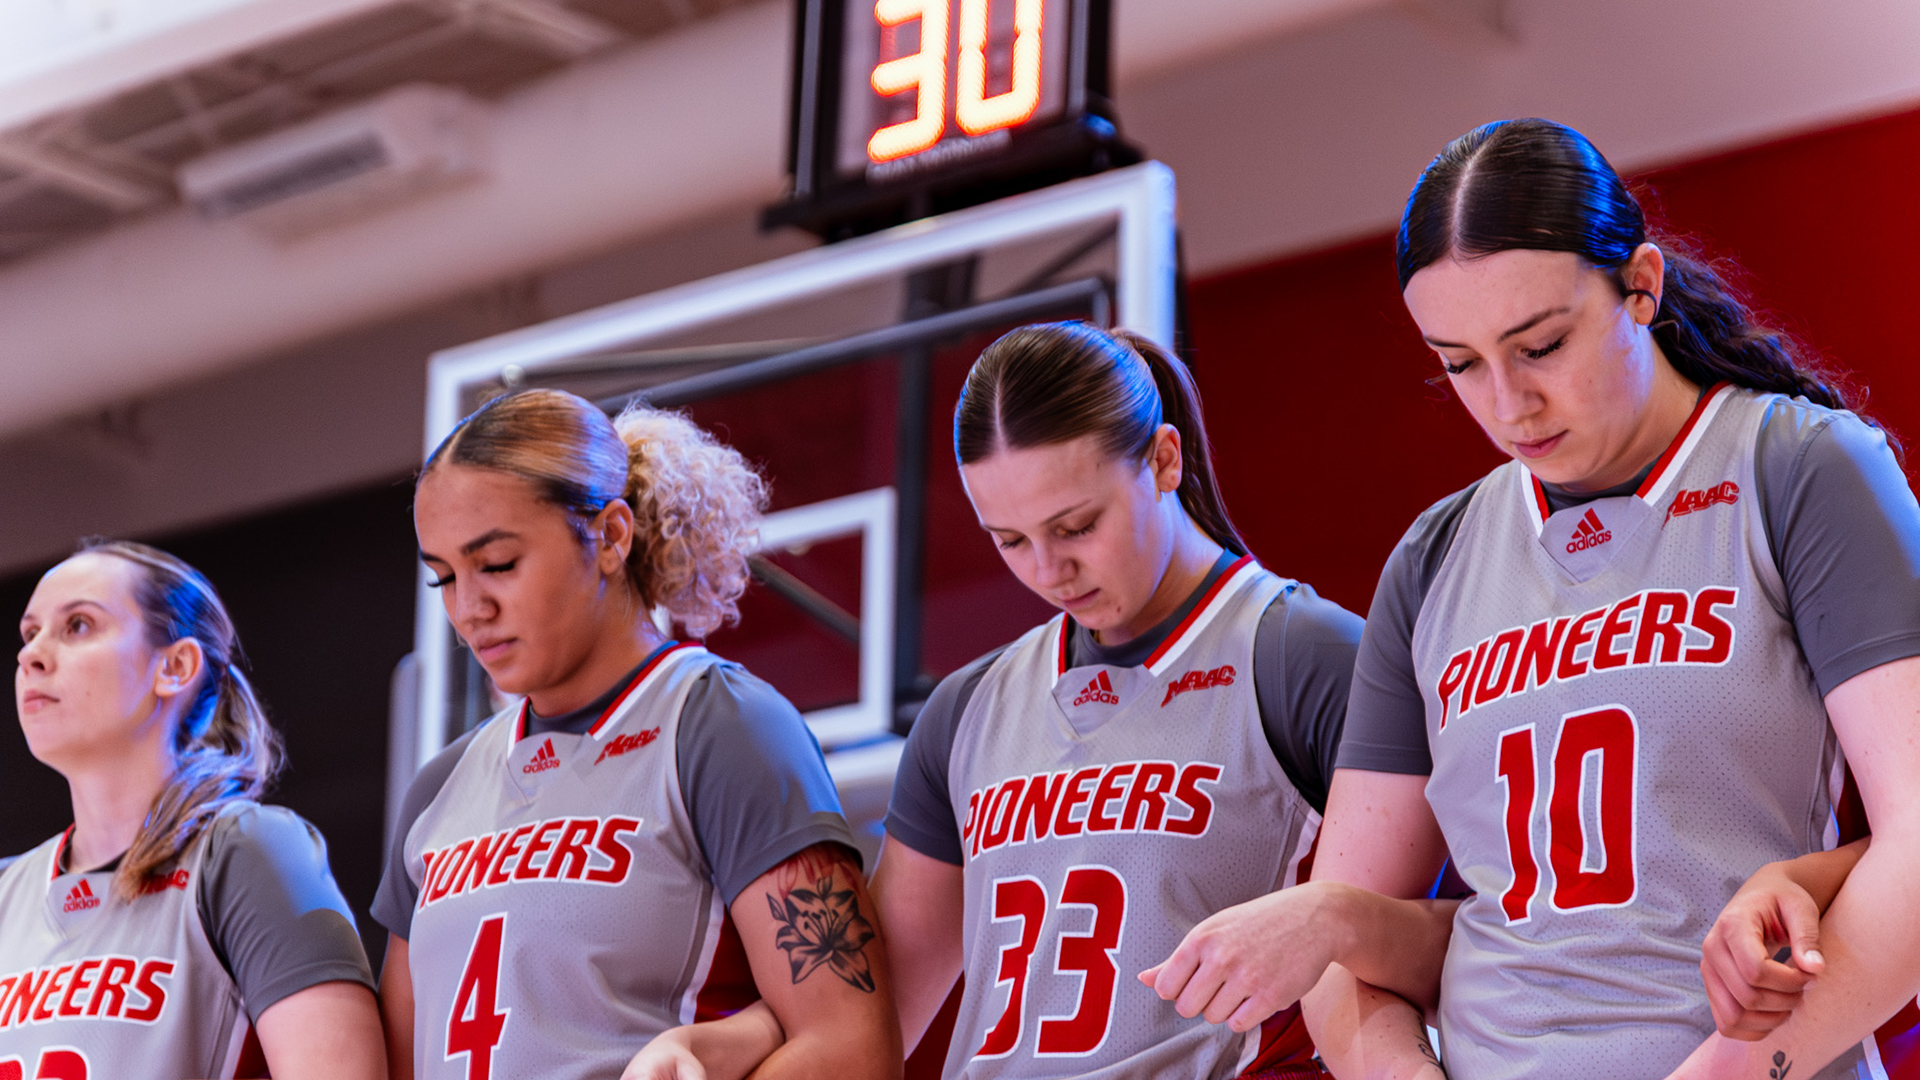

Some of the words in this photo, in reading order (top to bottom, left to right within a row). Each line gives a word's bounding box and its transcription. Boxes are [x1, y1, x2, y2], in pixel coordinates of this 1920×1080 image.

[867, 0, 1045, 163] 30
[1565, 529, 1613, 554] adidas
[1073, 689, 1120, 708] adidas
[1160, 664, 1237, 708] MAAC
[1437, 585, 1740, 735] PIONEERS
[522, 758, 561, 775] adidas
[963, 759, 1225, 861] PIONEERS
[1495, 703, 1639, 926] 10
[444, 911, 511, 1080] 4
[970, 864, 1128, 1062] 33
